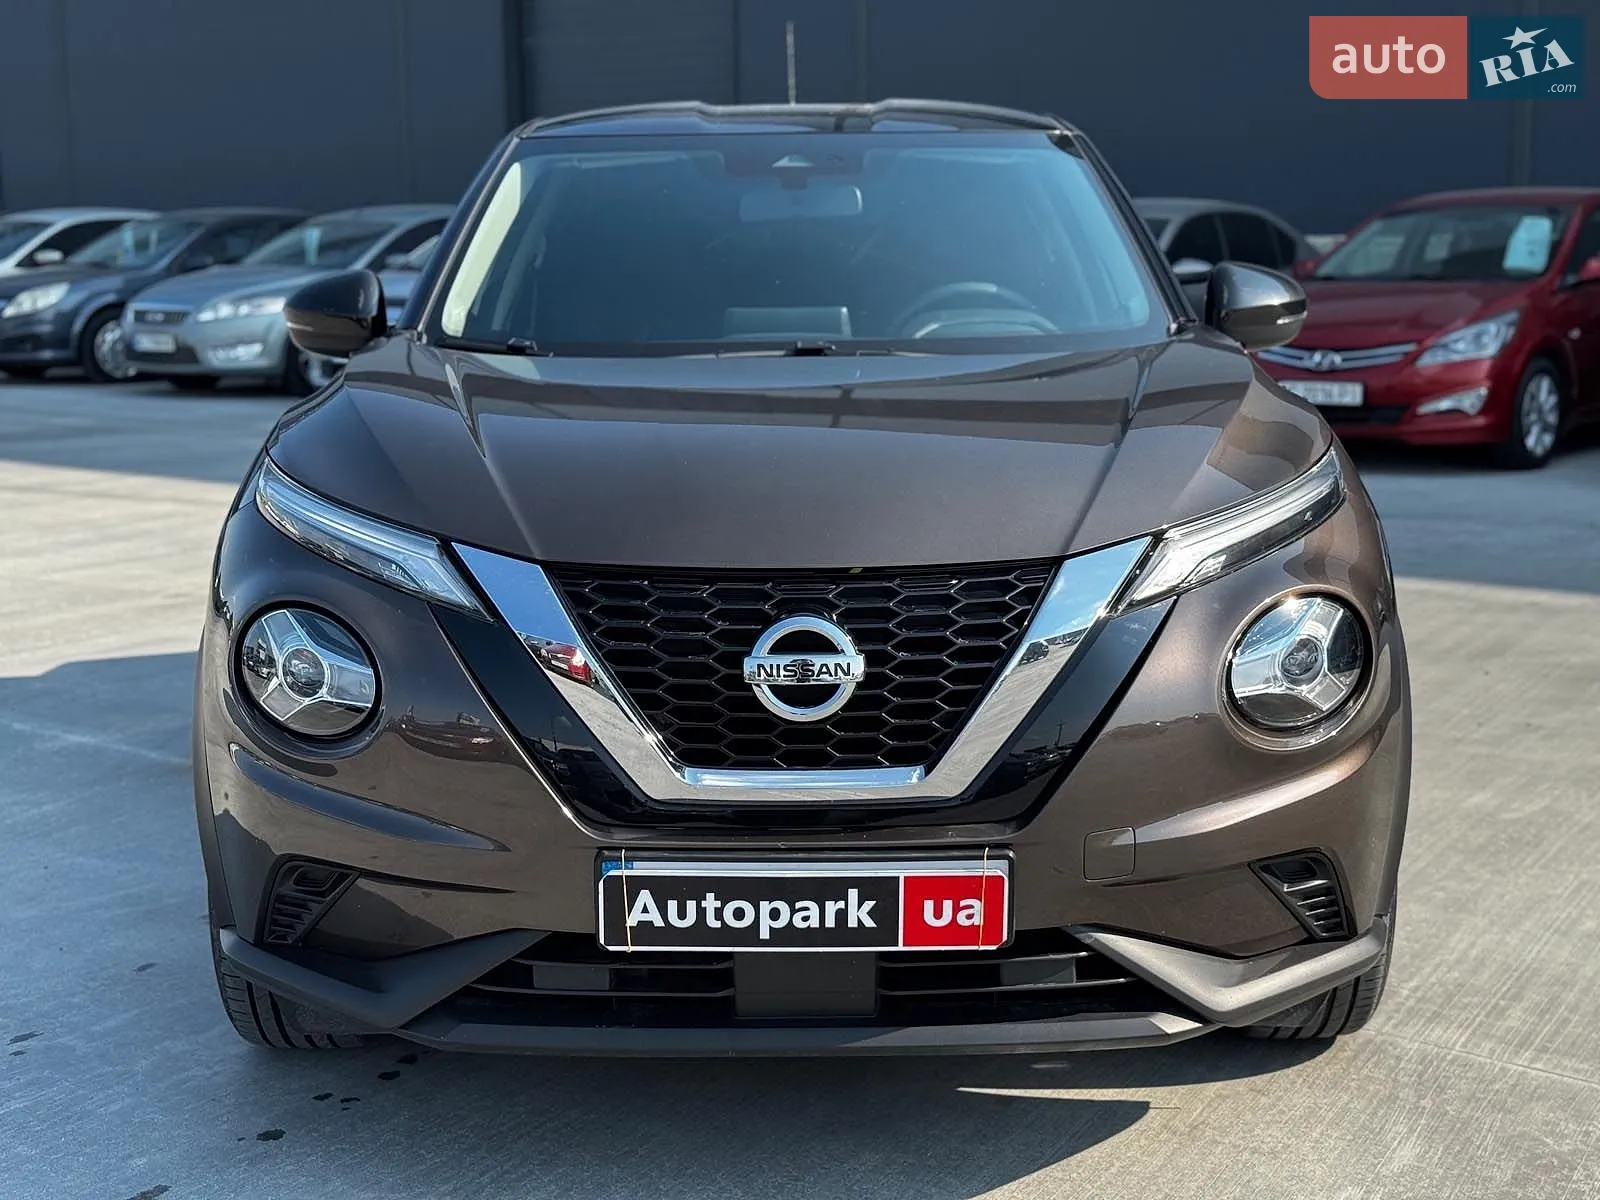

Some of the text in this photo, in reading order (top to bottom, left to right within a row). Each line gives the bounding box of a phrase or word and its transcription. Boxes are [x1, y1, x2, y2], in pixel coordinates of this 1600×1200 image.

[756, 662, 851, 679] NISSAN
[627, 888, 982, 939] Autopark ua
